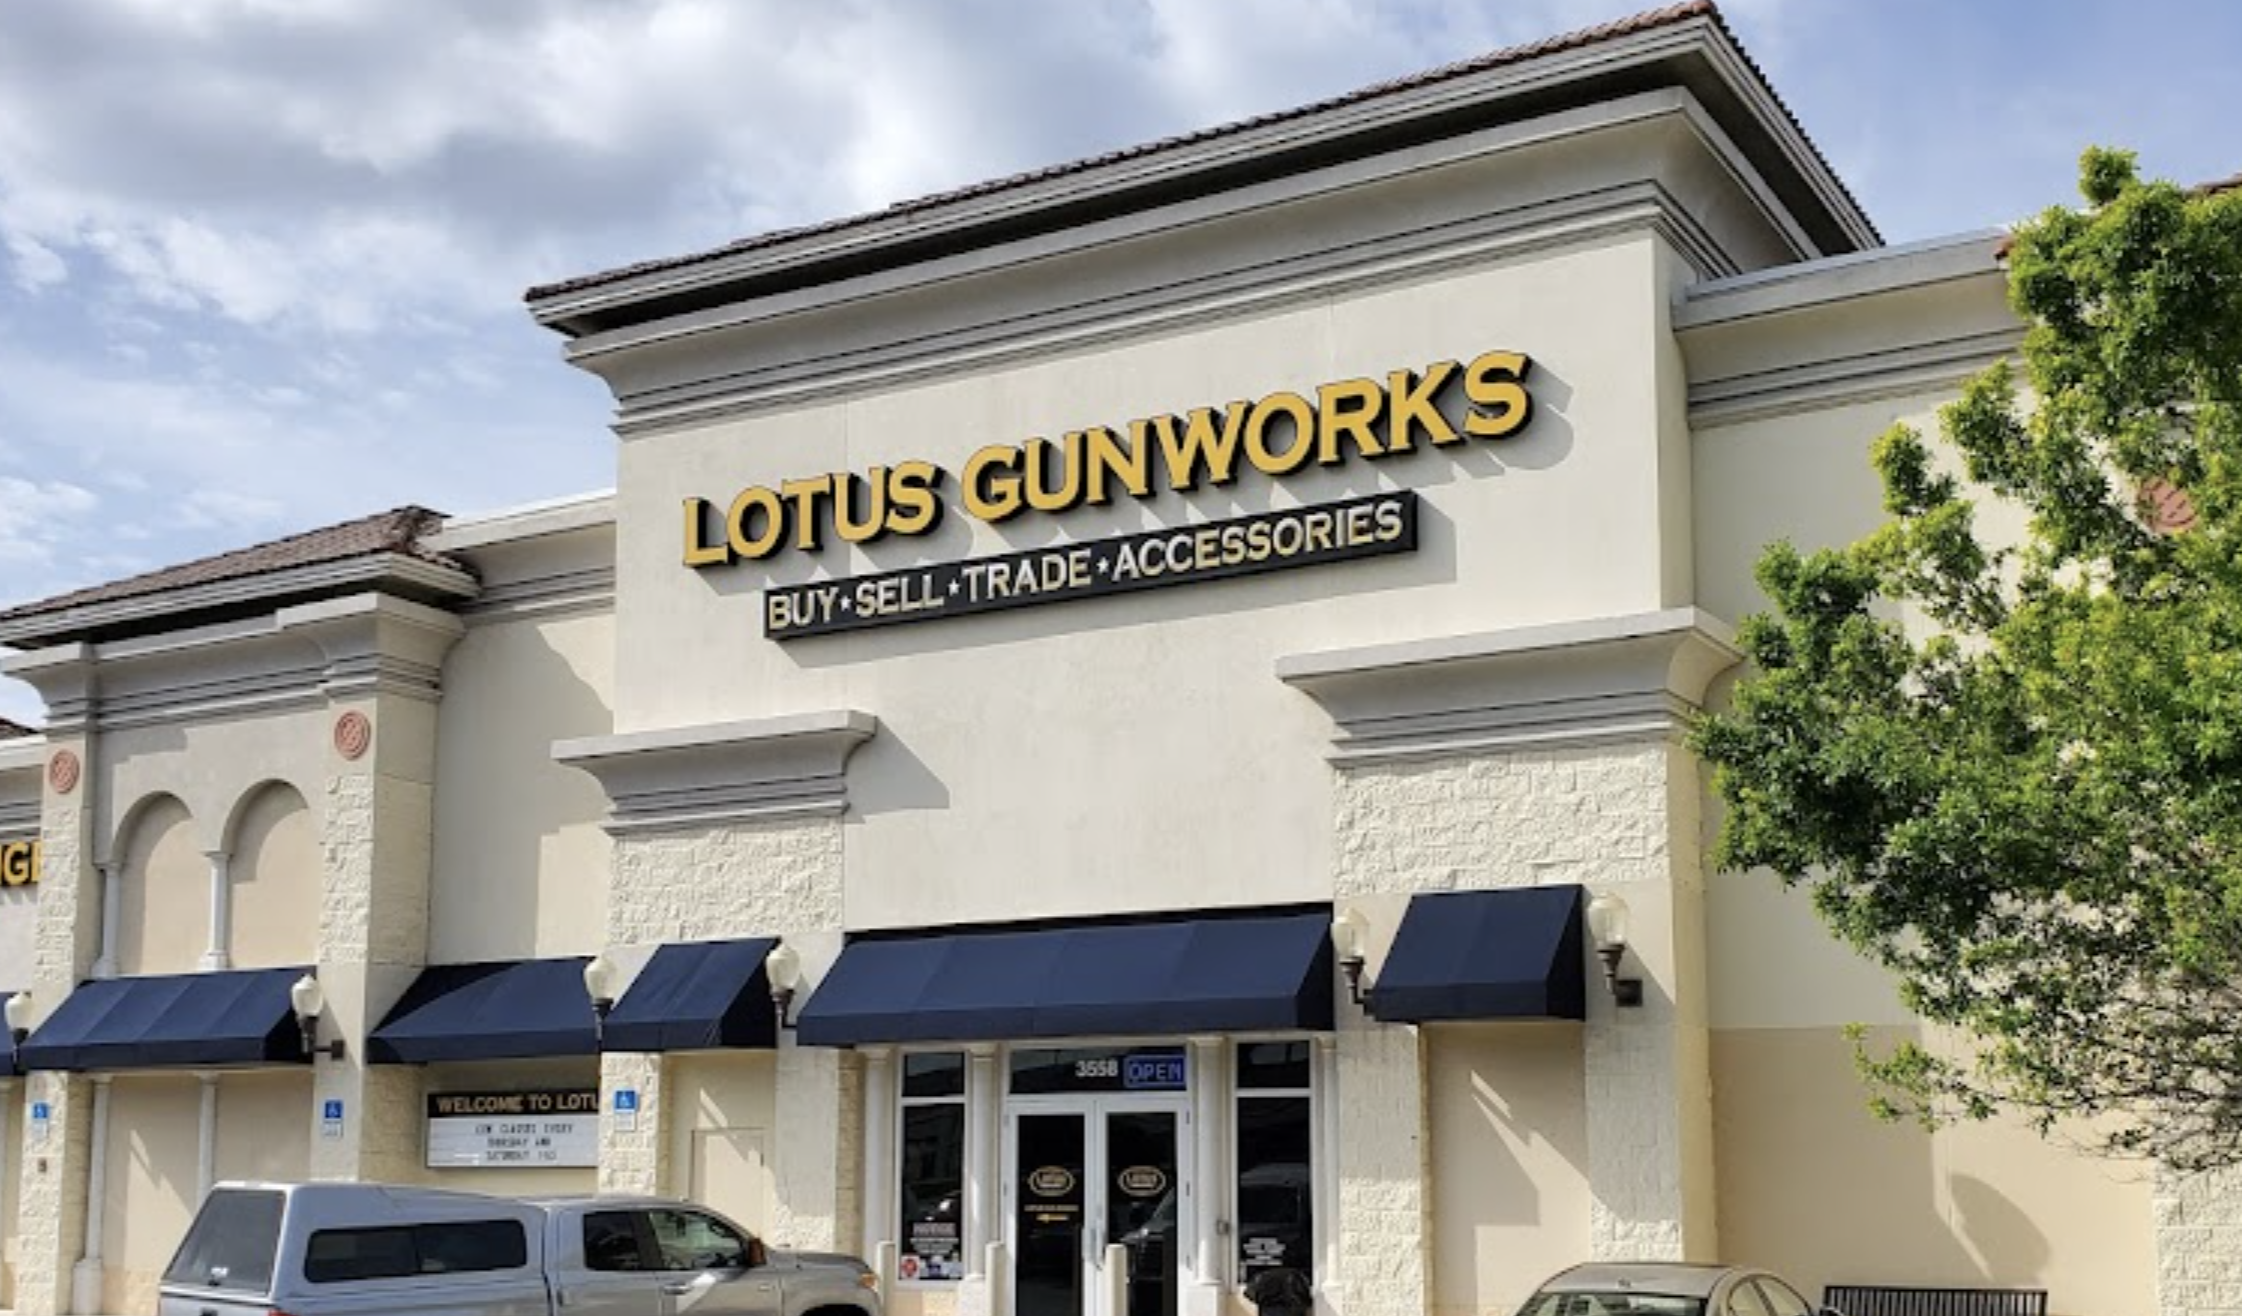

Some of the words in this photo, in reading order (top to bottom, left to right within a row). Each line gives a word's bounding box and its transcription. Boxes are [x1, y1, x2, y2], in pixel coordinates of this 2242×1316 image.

[682, 460, 943, 568] LOTUS
[961, 350, 1533, 524] GUNWORKS
[768, 586, 840, 630] BUY
[856, 574, 945, 618] SELL
[962, 548, 1092, 603] TRADE
[1113, 501, 1403, 583] ACCESSORIES
[1075, 1060, 1119, 1078] 3558
[1128, 1063, 1182, 1081] OPEN
[437, 1095, 524, 1113] WELCOME
[527, 1093, 552, 1110] TO
